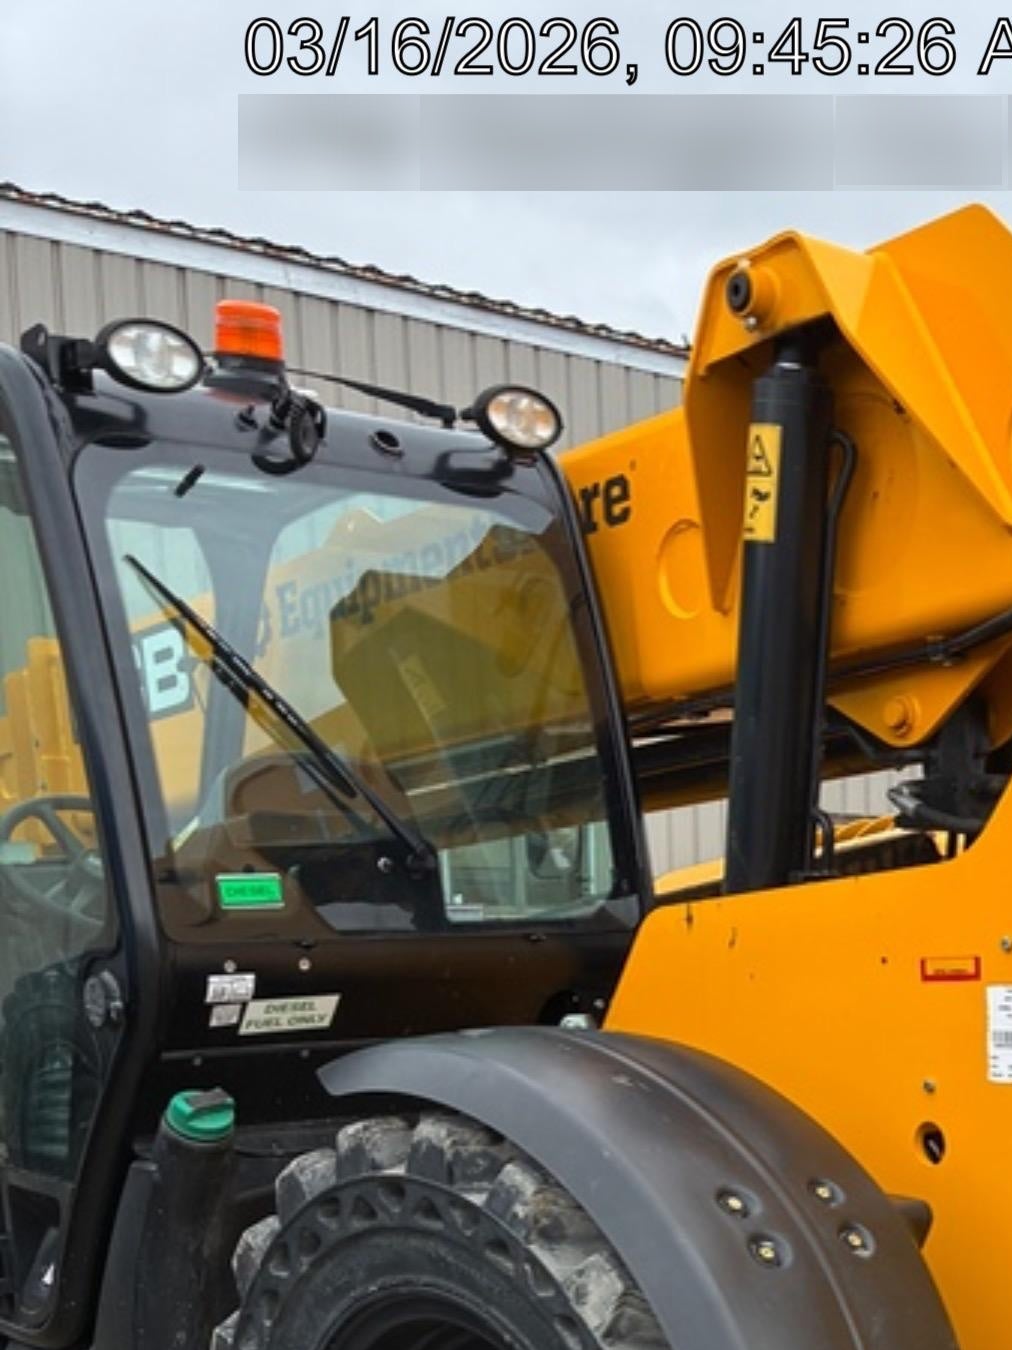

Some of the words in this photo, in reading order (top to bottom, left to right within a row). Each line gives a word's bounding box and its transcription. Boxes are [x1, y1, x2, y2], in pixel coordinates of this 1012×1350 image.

[263, 1001, 315, 1015] DIESEL
[245, 1017, 282, 1030] FUEL
[287, 1014, 328, 1027] ONLY
